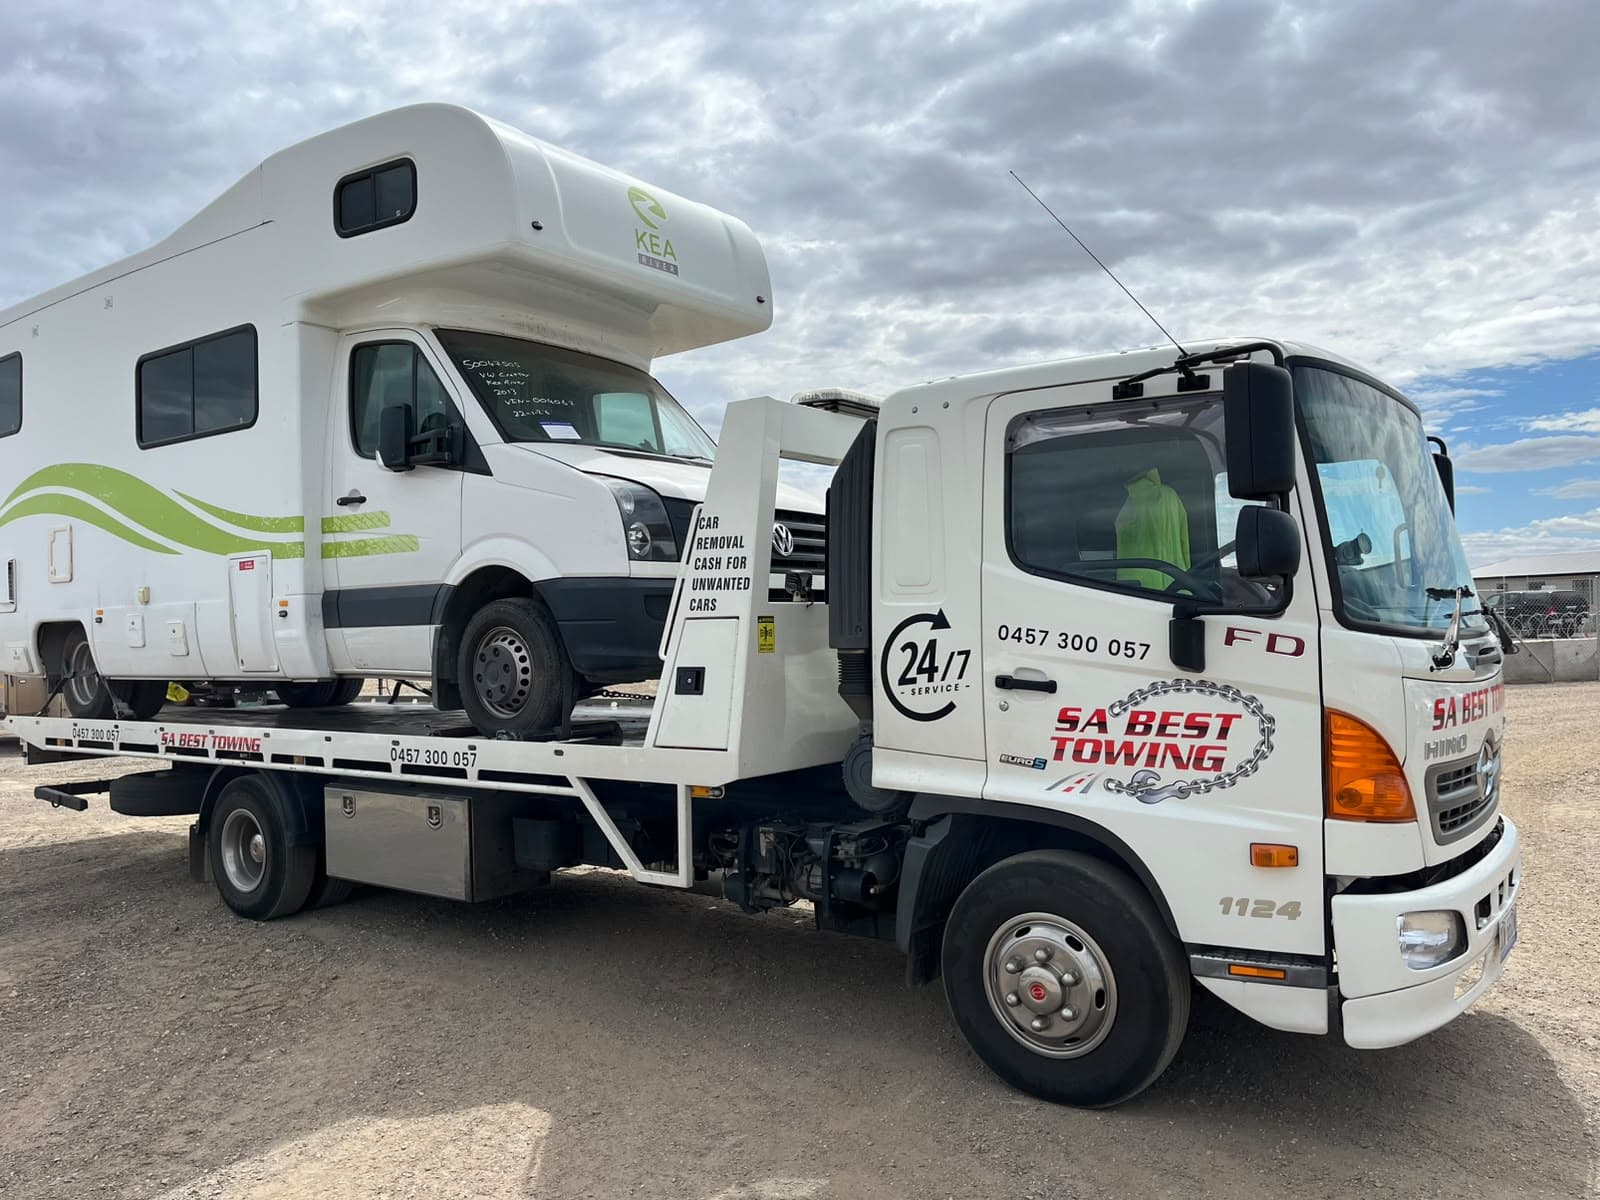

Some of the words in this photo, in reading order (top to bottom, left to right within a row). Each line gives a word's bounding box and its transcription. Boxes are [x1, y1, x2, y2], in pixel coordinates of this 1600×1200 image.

[634, 228, 677, 261] KEA
[698, 516, 719, 530] CAR
[696, 535, 745, 550] REMOVAL
[694, 557, 722, 571] CASH
[726, 556, 747, 570] FOR
[692, 577, 750, 591] UNWANTED
[689, 599, 717, 612] CARS
[997, 624, 1049, 647] 0457
[1057, 632, 1098, 653] 300
[1108, 639, 1151, 661] 057
[897, 638, 971, 686] 24/7
[1432, 696, 1457, 731] SA
[1462, 688, 1489, 725] BEST
[72, 727, 89, 739] 0457
[90, 728, 104, 740] 300
[106, 729, 120, 741] 057
[1055, 707, 1109, 734] SA
[1124, 710, 1242, 741] BEST
[161, 732, 176, 746] SA
[178, 733, 209, 749] BEST
[211, 735, 261, 753] TOWING
[1424, 734, 1468, 760] HINO
[390, 748, 420, 764] 0457
[424, 750, 448, 765] 300
[453, 752, 477, 768] 057
[1050, 736, 1228, 773] TOWING
[1219, 896, 1302, 921] 1124
